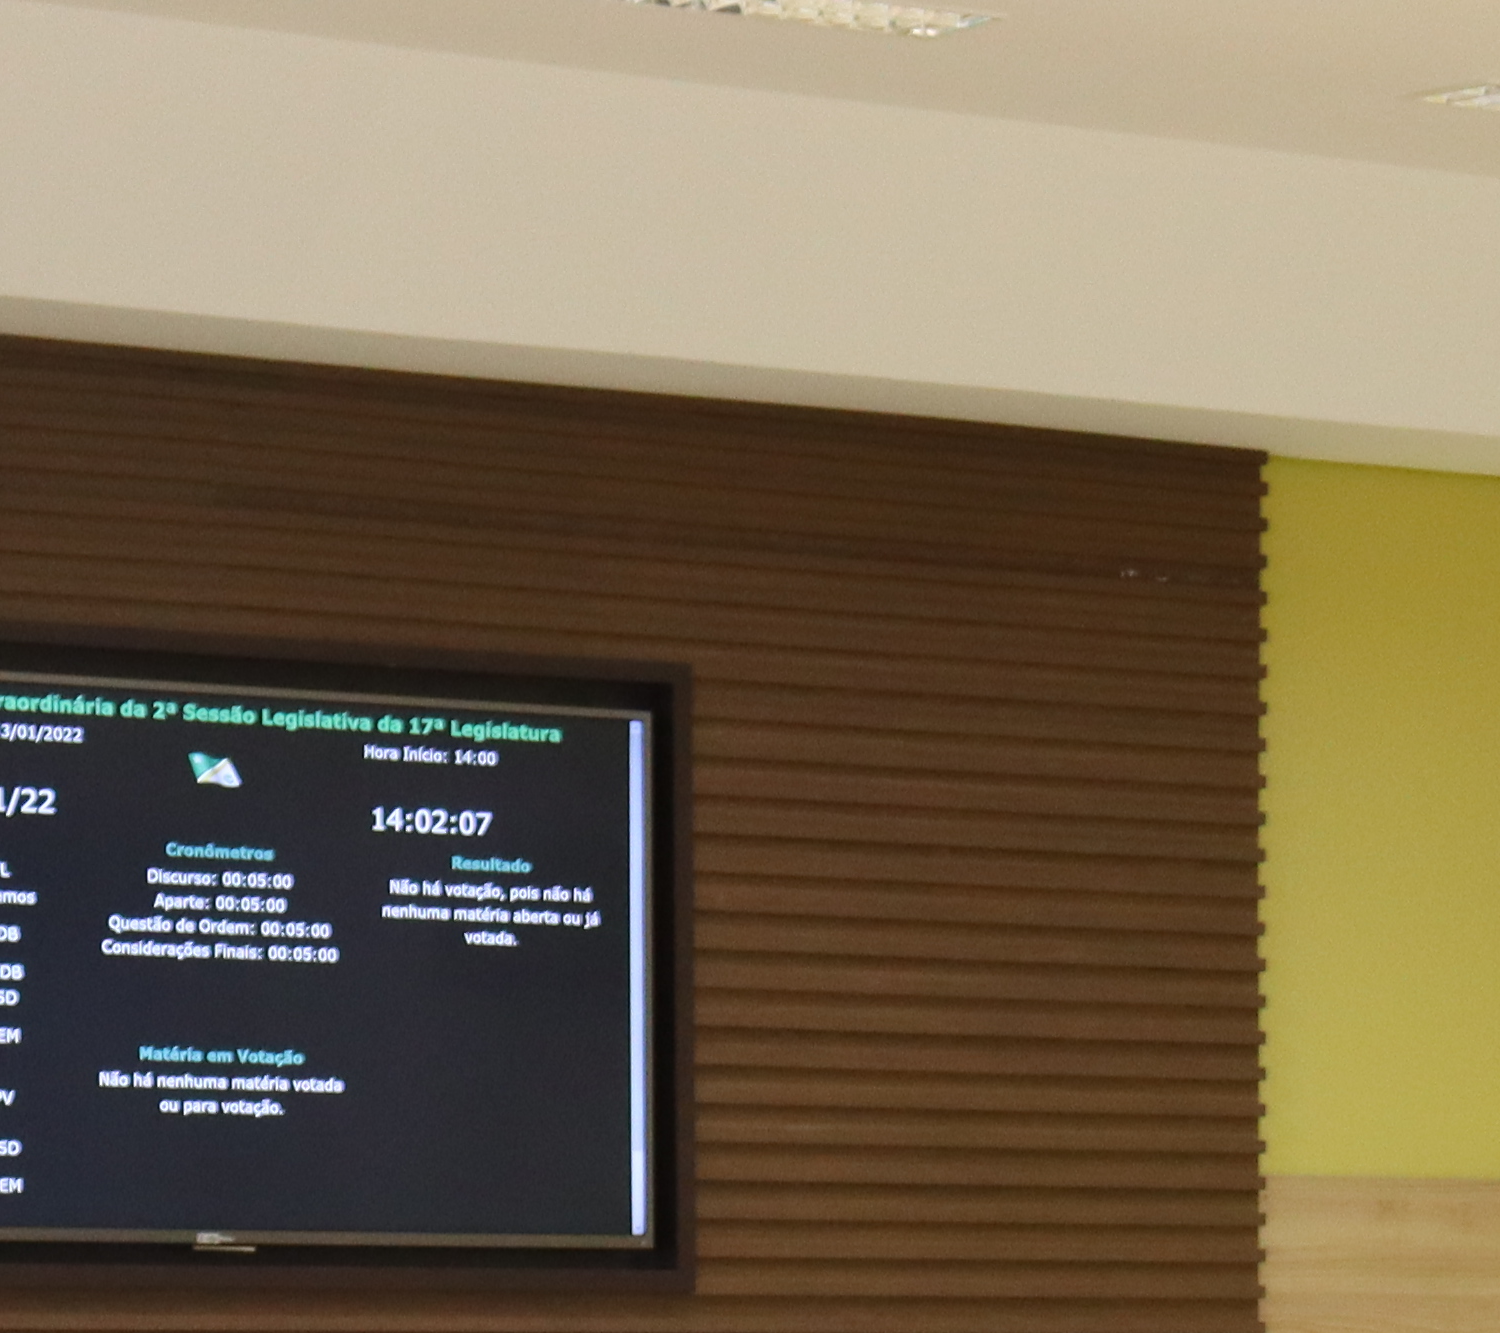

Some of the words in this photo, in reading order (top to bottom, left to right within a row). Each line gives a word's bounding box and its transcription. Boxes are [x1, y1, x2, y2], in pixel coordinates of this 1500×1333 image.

[120, 699, 148, 718] da
[153, 701, 178, 720] 2ª
[183, 703, 258, 725] Sessão
[262, 709, 373, 732] Legislativa
[377, 715, 404, 734] da
[410, 717, 446, 735] 17ª
[451, 720, 562, 743] Legislatura
[364, 744, 401, 761] Hora
[403, 745, 449, 763] Início:
[455, 749, 499, 766] 14:00
[372, 806, 493, 836] 14:02:07
[166, 841, 275, 861] Cronômetros
[452, 855, 532, 873] Resultado
[147, 867, 219, 886] Discurso:
[222, 871, 295, 890] 00:05:00
[389, 878, 421, 895] Não
[422, 880, 443, 896] há
[444, 882, 507, 901] votação,
[510, 885, 541, 902] pois
[543, 885, 572, 902] não
[573, 887, 594, 903] há
[154, 892, 212, 911] Aparte:
[215, 894, 288, 914] 00:05:00
[108, 913, 174, 934] Questão
[175, 917, 197, 934] de
[198, 917, 257, 936] Ordem:
[261, 920, 333, 939] 00:05:00
[382, 903, 452, 921] nenhuma
[454, 906, 512, 923] matéria
[513, 908, 561, 925] aberta
[563, 912, 583, 926] ou
[584, 910, 601, 929] já
[464, 930, 519, 946] votada.
[101, 938, 212, 960] Considerações
[214, 941, 264, 960] Finais:
[268, 944, 340, 963] 00:05:00
[139, 1045, 204, 1062] Matéria
[207, 1050, 234, 1063] em
[237, 1048, 305, 1067] Votação
[99, 1070, 131, 1087] Não
[133, 1071, 155, 1088] há
[157, 1072, 229, 1090] nenhuma
[231, 1074, 291, 1092] matéria
[292, 1077, 346, 1093] votada
[159, 1099, 182, 1113] ou
[183, 1099, 219, 1115] para
[221, 1098, 285, 1118] votação.
